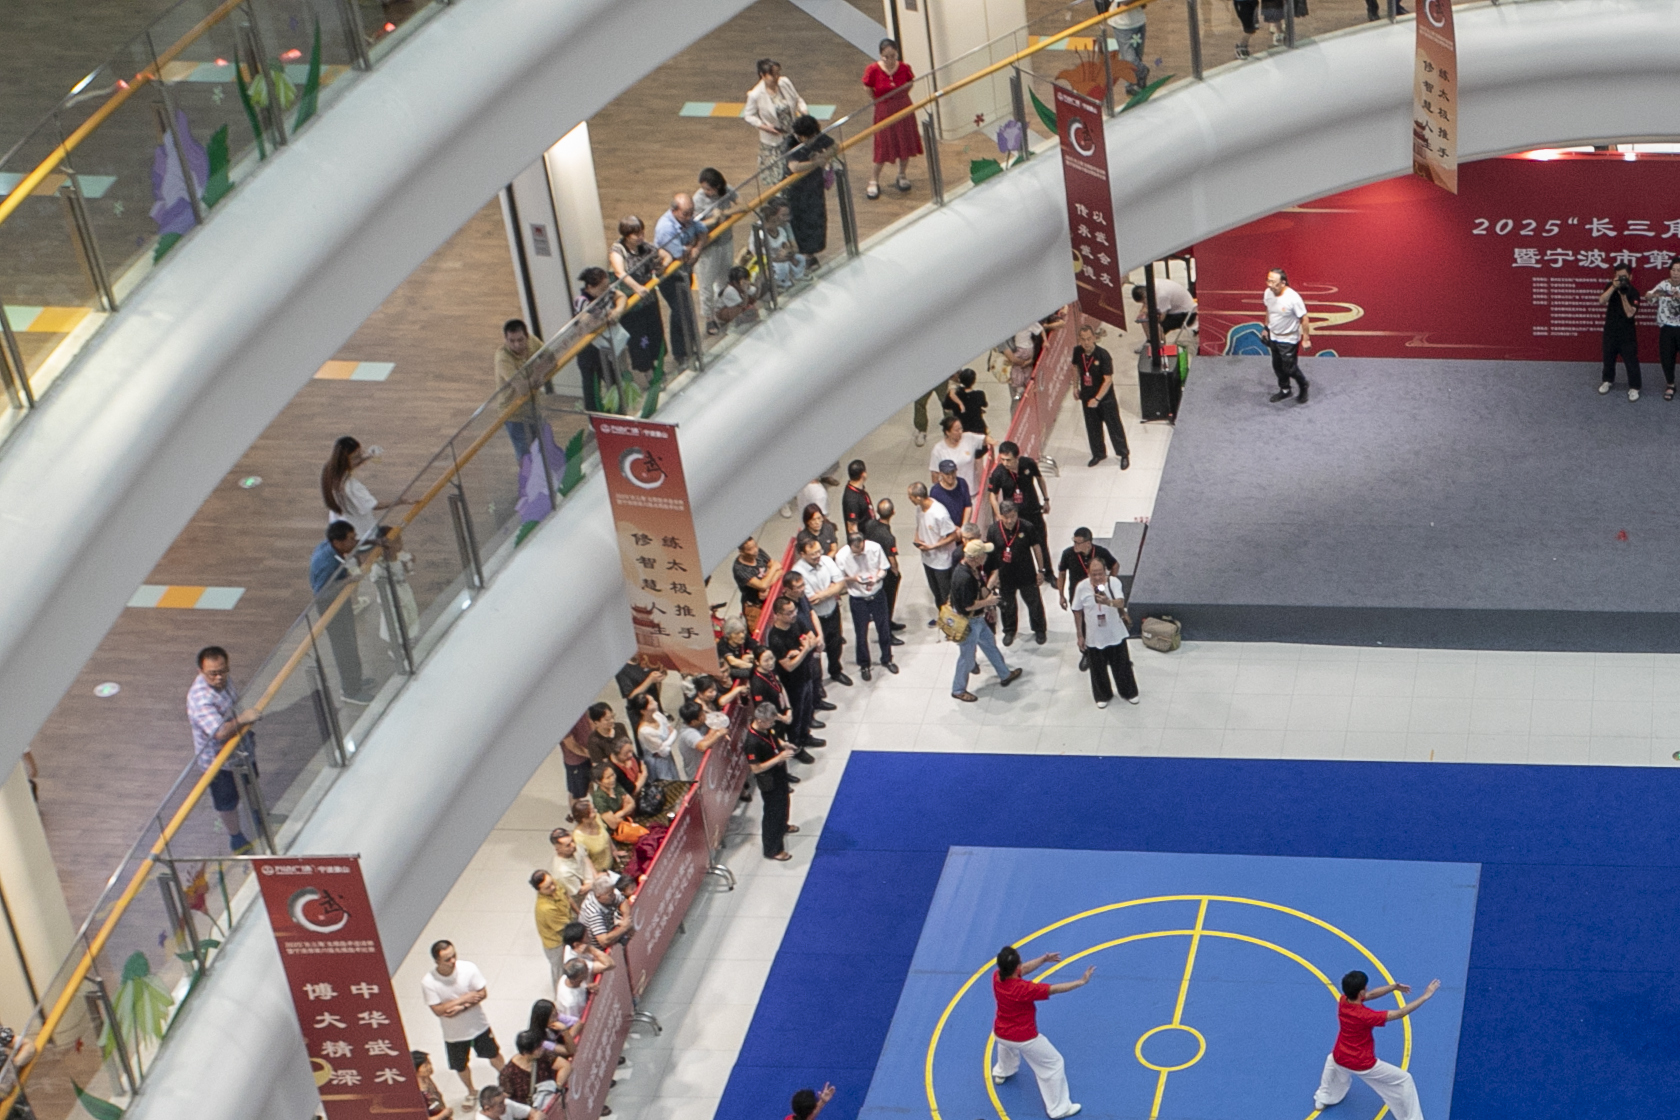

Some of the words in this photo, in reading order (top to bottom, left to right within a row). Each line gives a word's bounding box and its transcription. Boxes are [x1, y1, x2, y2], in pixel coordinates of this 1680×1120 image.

[631, 532, 670, 637] 修智慧人生
[662, 535, 699, 639] 练太极推手
[303, 982, 362, 1086] 博大精深
[350, 982, 407, 1085] 中华武术
